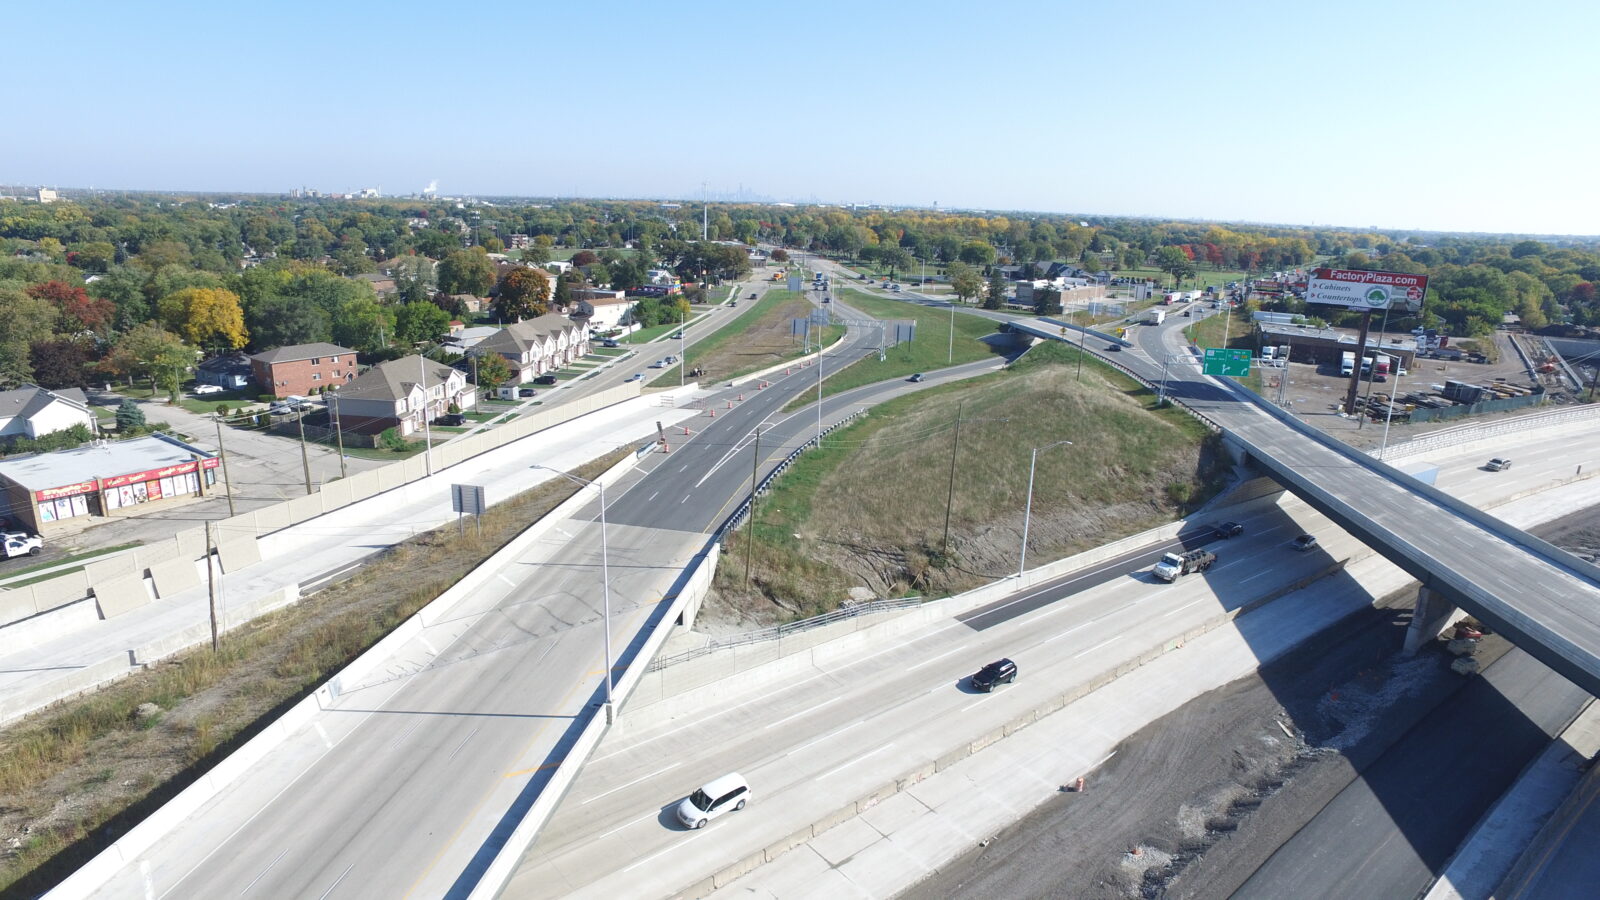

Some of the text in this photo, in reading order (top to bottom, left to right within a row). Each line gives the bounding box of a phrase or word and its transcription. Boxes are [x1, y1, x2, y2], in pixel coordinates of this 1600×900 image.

[1330, 270, 1417, 285] FactoryPlaza.com
[1319, 282, 1351, 292] Cabinets
[1316, 292, 1362, 304] Countertops
[80, 482, 92, 492] 5
